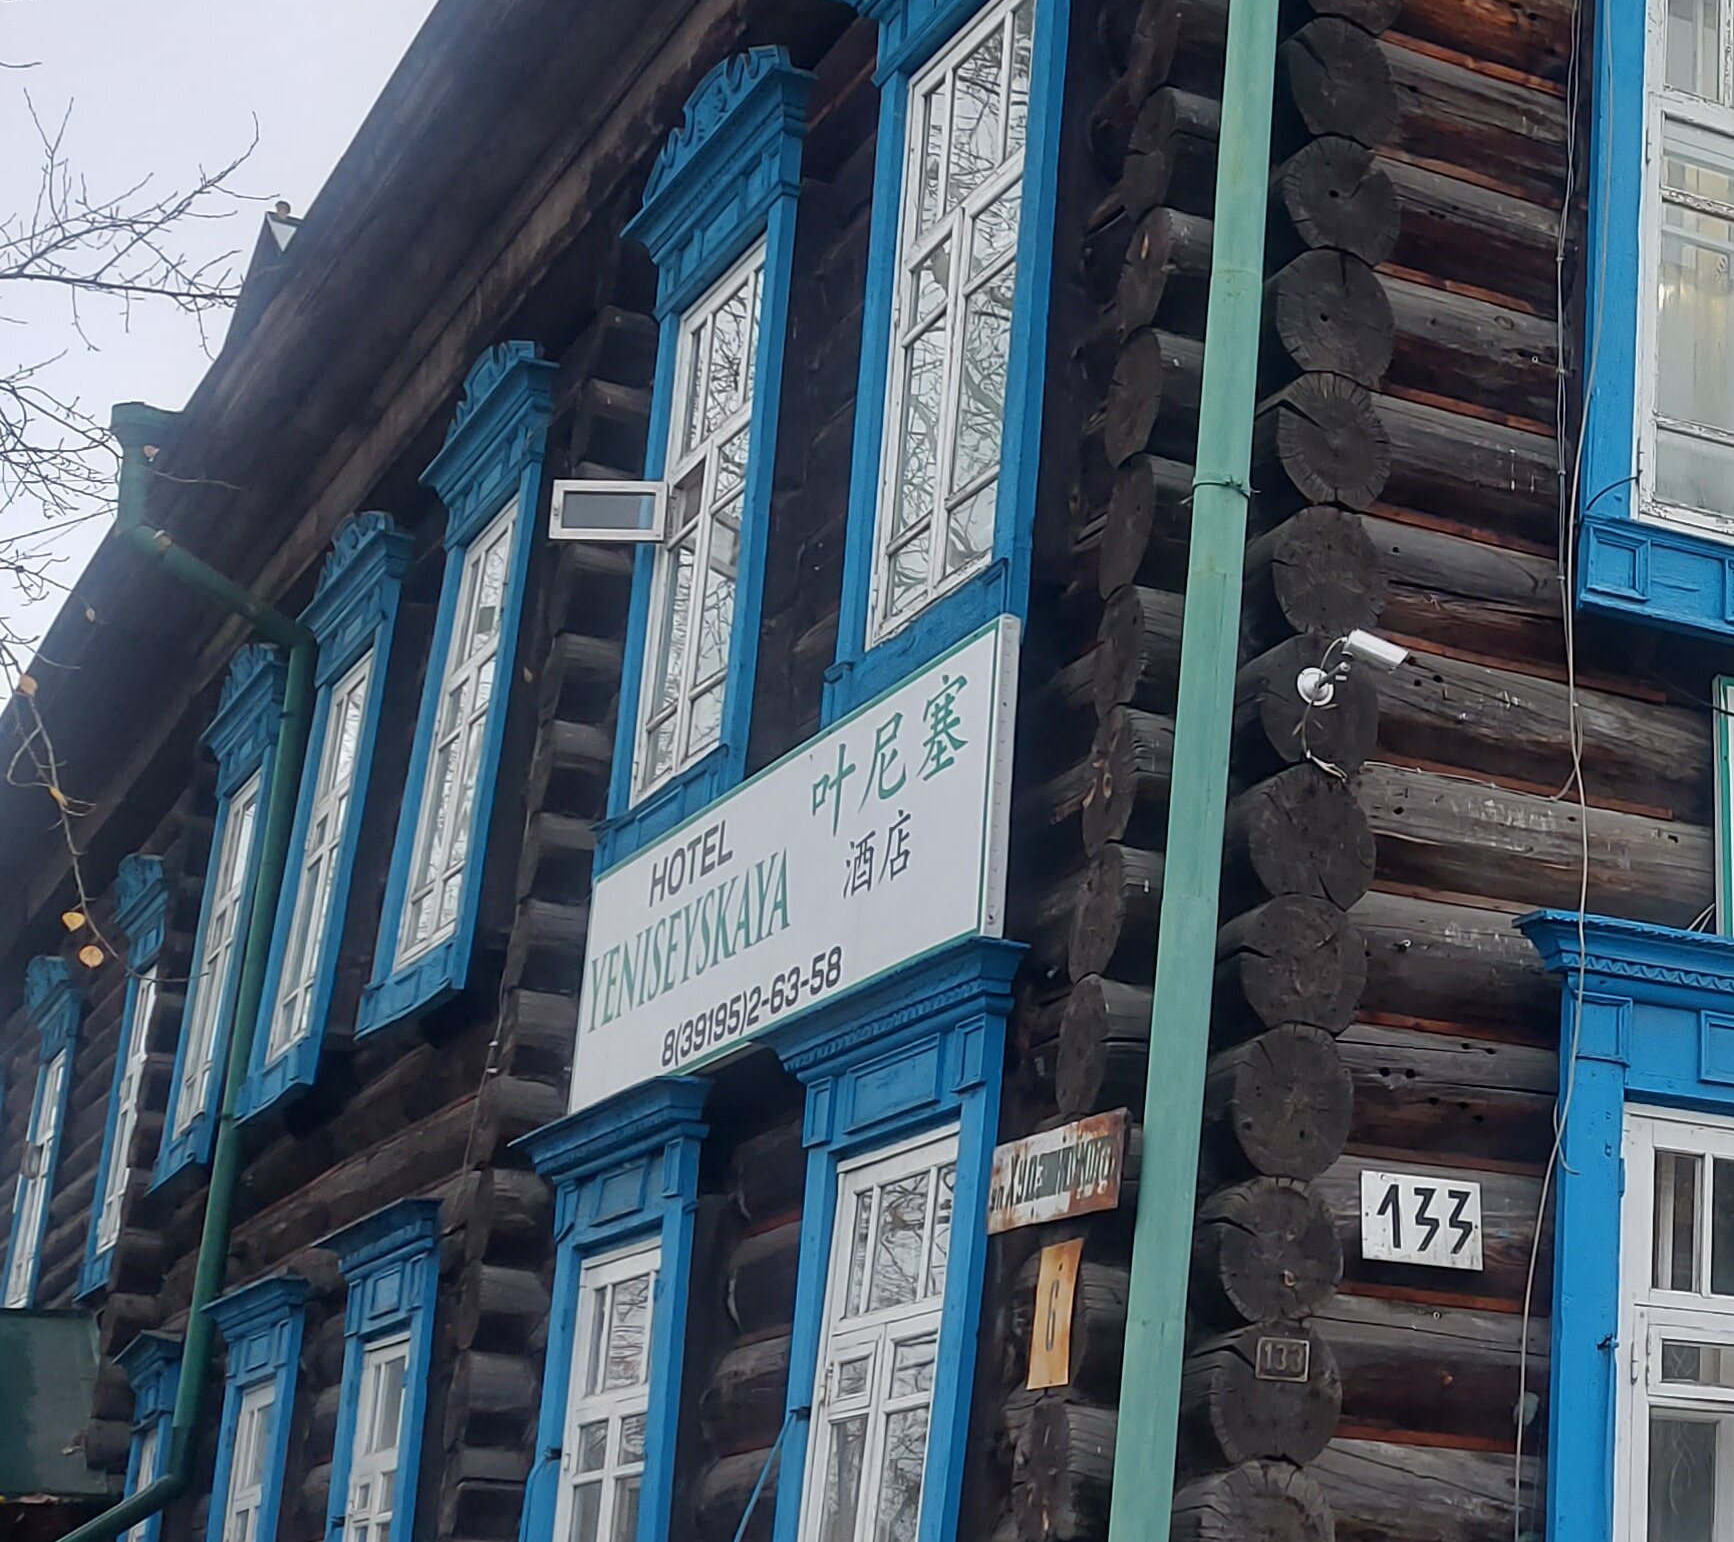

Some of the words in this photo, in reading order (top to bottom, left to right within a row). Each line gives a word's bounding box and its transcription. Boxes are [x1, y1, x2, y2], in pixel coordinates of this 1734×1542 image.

[810, 673, 970, 837] 叶尼塞
[649, 819, 734, 908] HOTEL
[843, 809, 913, 899] 酒店
[587, 847, 791, 1033] YENISEYSKAYA
[661, 946, 843, 1068] 8(39195)2-63-58
[1376, 1183, 1474, 1256] 133
[1264, 1342, 1304, 1373] 133
